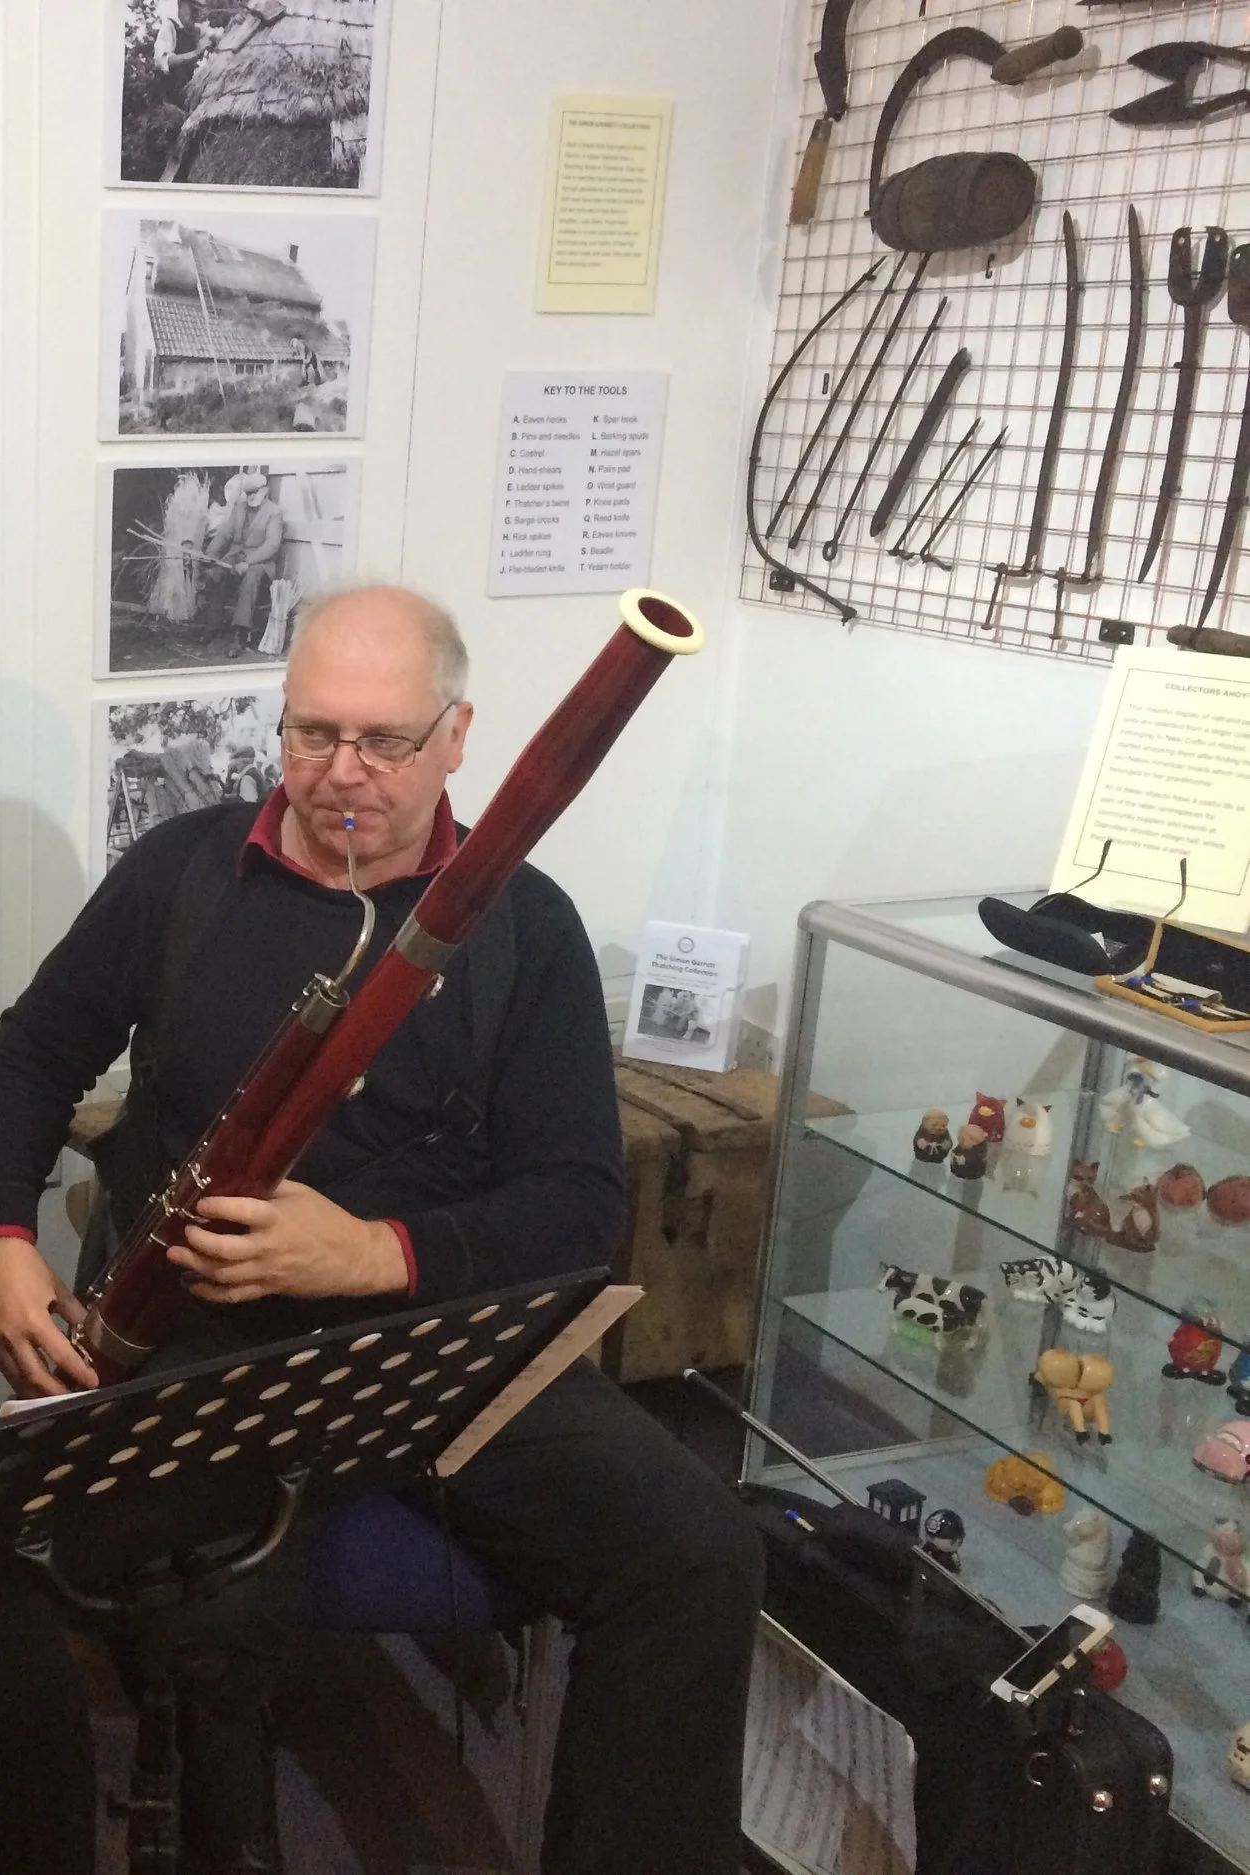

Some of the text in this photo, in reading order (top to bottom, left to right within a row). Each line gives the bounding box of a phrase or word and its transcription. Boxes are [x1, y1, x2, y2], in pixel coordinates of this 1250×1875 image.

[544, 386, 628, 395] KEY TO THE TOOLS
[1165, 683, 1221, 696] COLLECTORS
[685, 967, 719, 977] Collection
